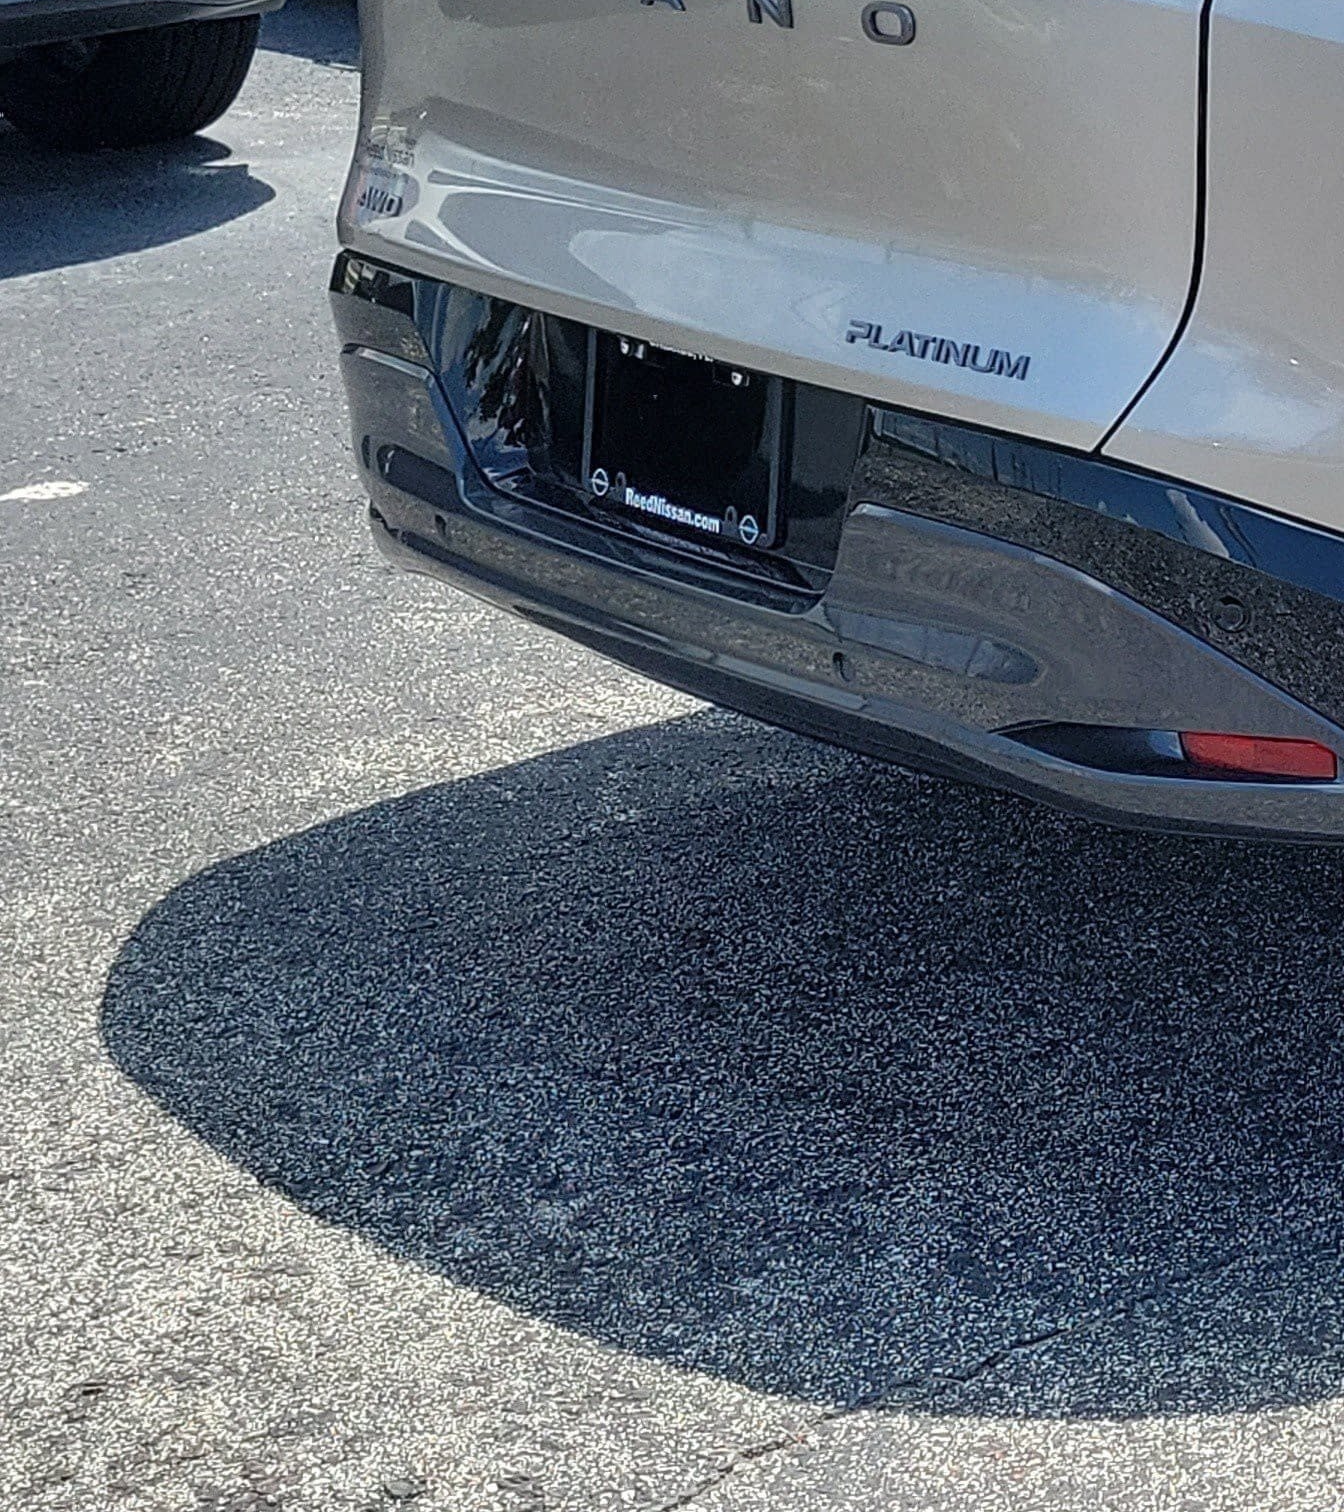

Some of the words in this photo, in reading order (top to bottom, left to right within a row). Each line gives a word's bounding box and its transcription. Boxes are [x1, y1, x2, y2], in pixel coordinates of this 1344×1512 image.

[357, 187, 403, 217] AWD
[846, 319, 1032, 381] PLATINUM
[624, 487, 720, 534] ReedNissan.com
